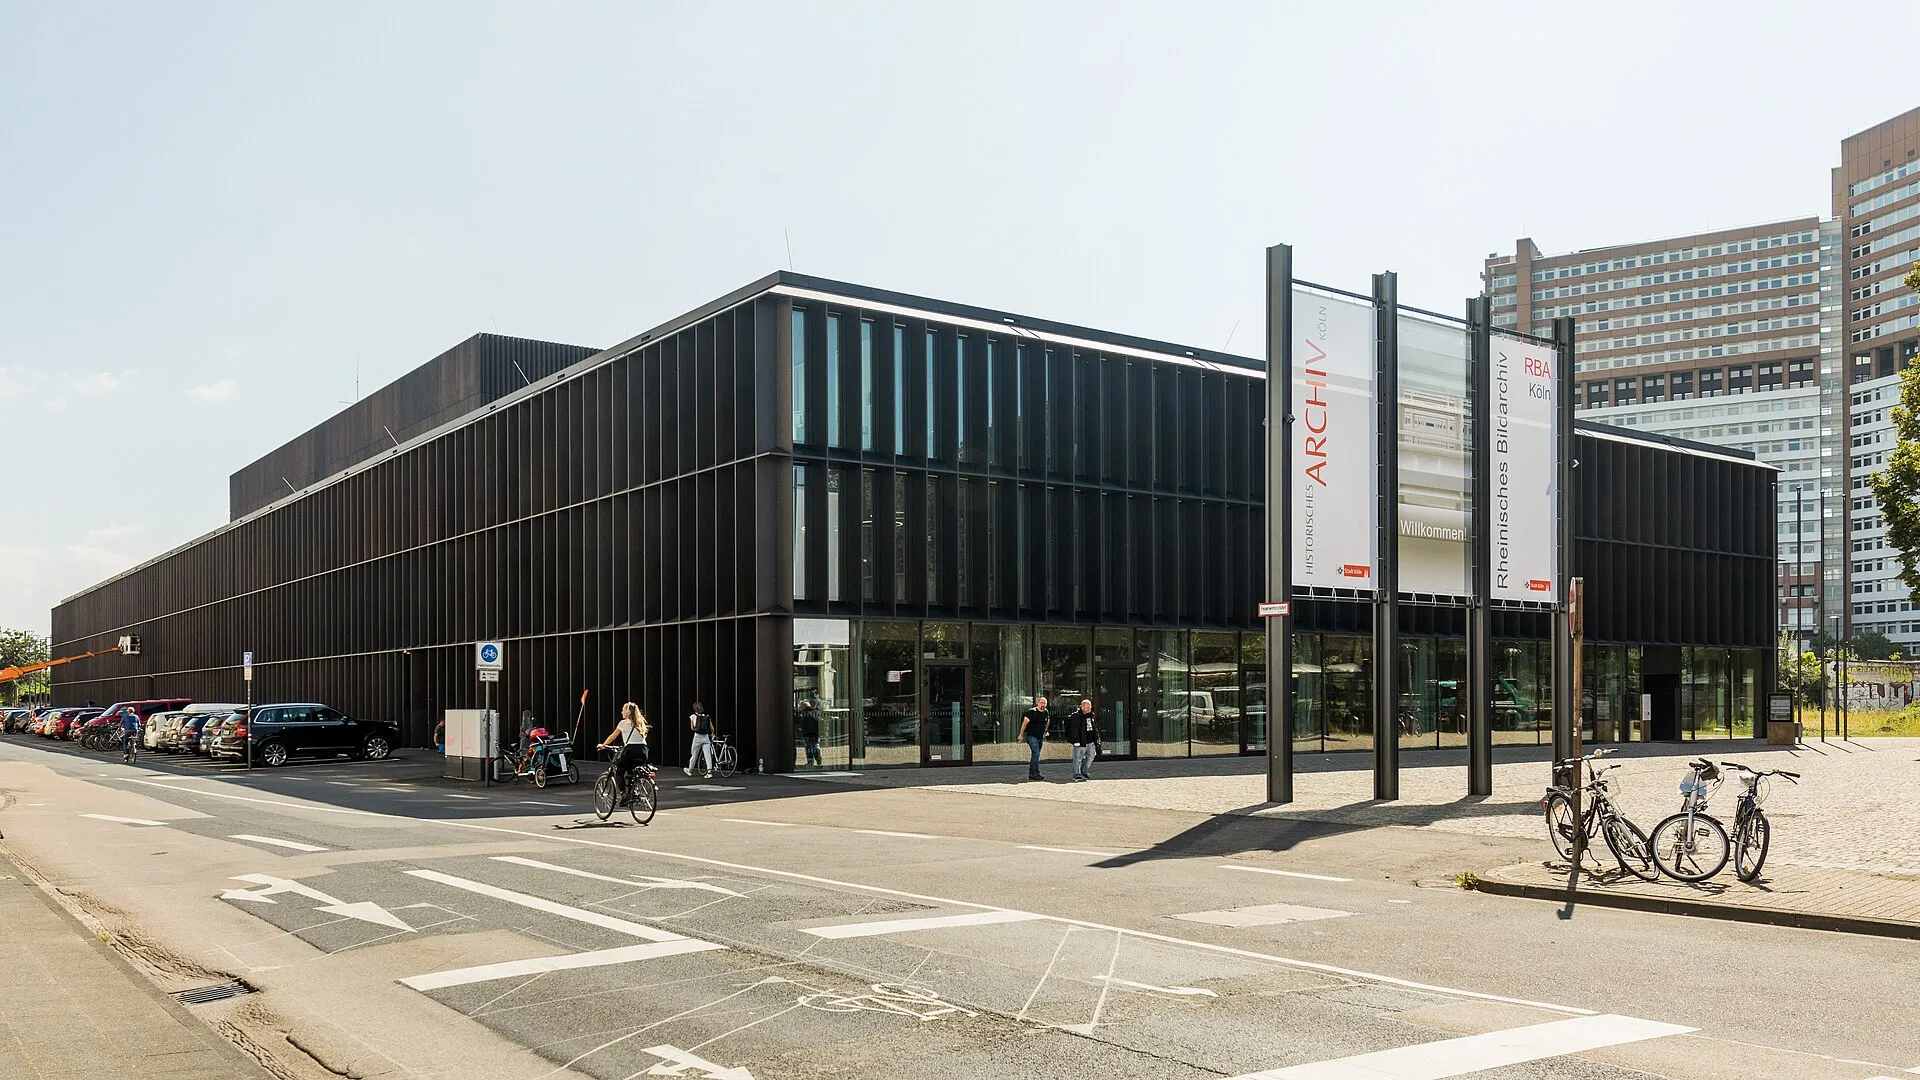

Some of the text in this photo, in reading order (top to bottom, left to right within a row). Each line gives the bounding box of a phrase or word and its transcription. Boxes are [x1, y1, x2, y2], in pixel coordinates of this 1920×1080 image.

[1316, 306, 1327, 340] KÖLN
[1524, 357, 1551, 379] RBA
[1529, 382, 1551, 400] Köln
[1305, 338, 1327, 487] ARCHIV
[1497, 351, 1508, 589] Rheinisches Bildarchiv
[1305, 484, 1314, 575] HISTORISCHES
[1400, 519, 1467, 541] Willkommen!
